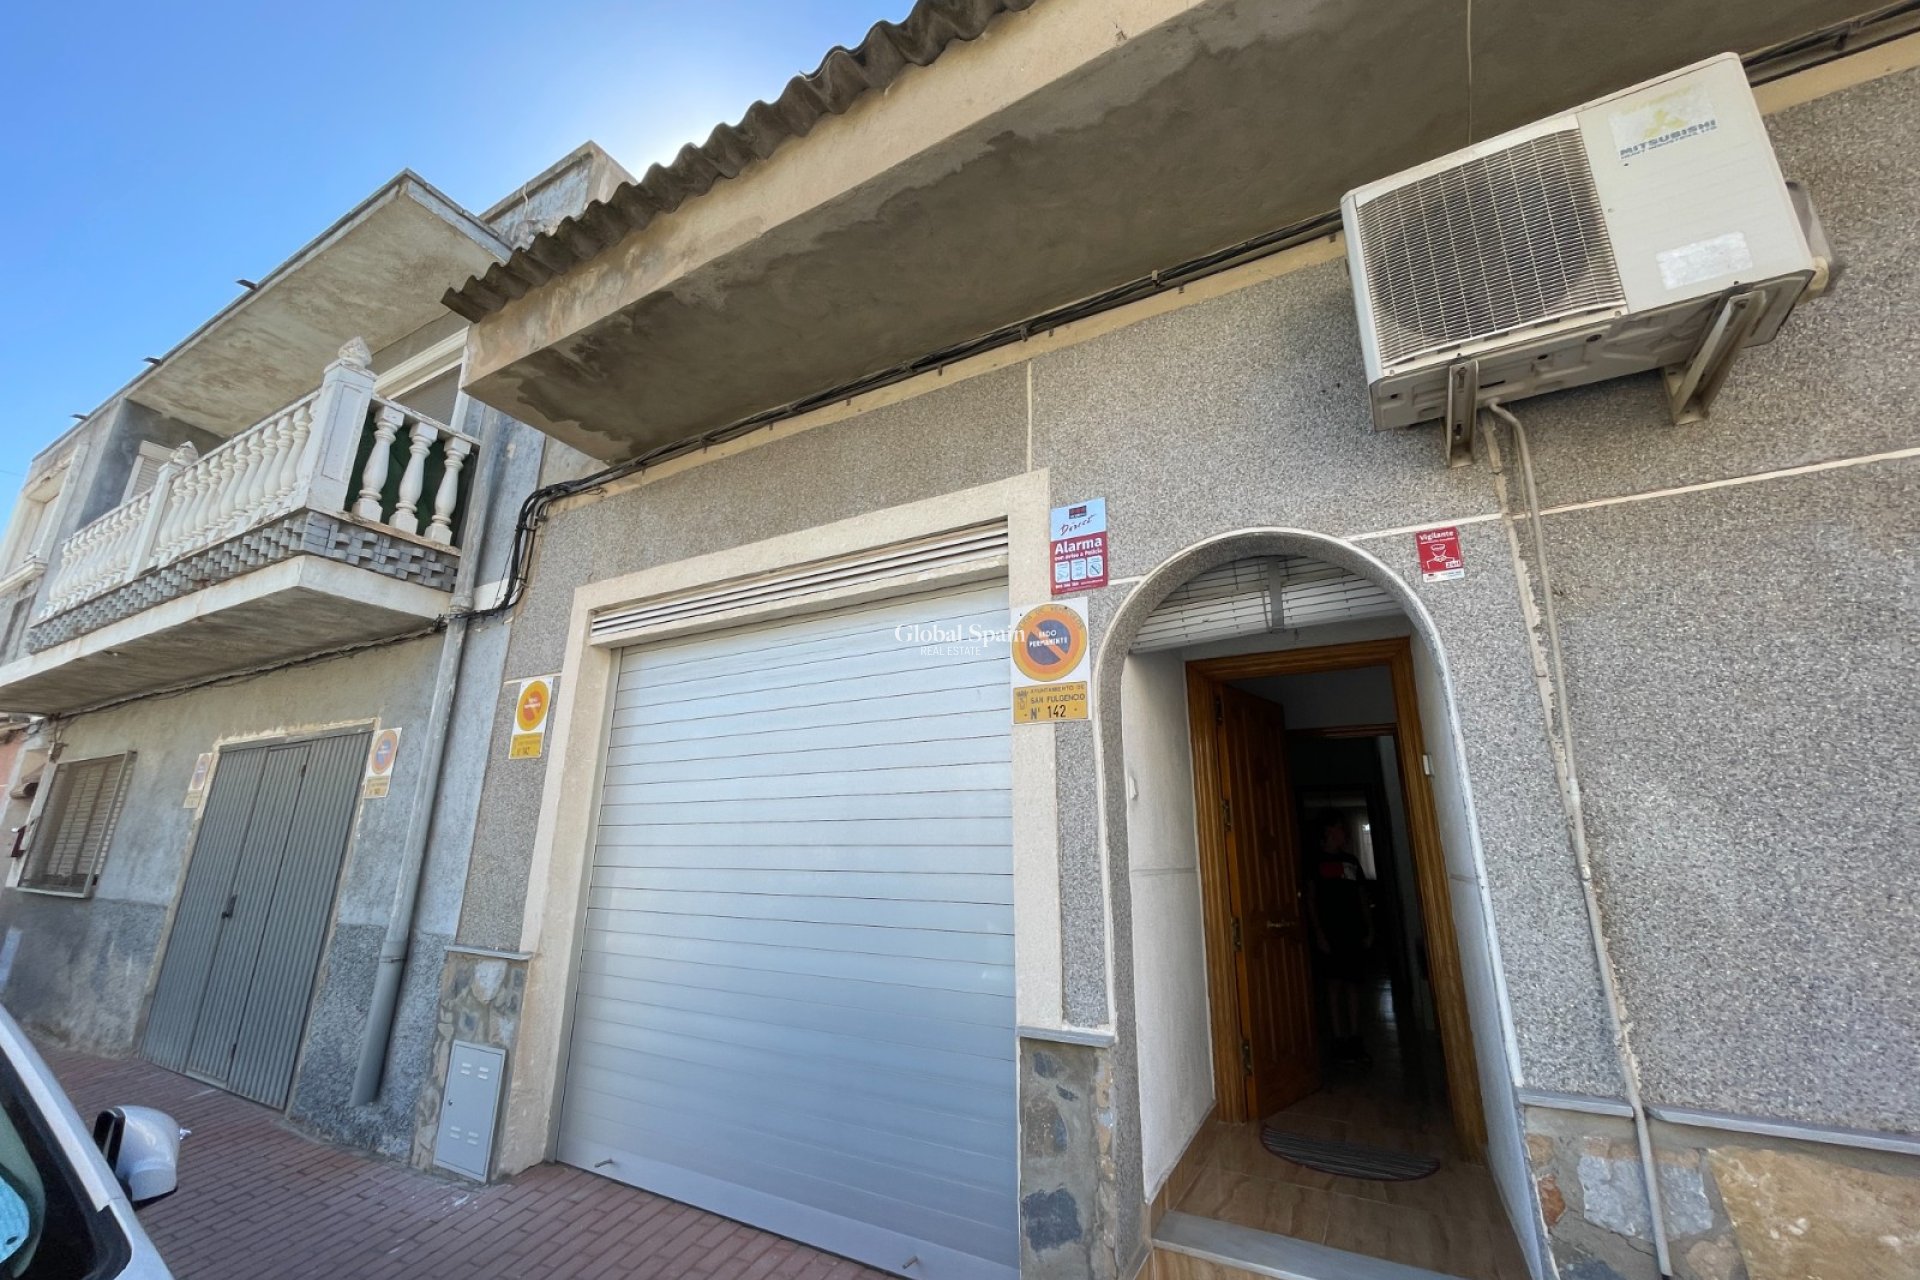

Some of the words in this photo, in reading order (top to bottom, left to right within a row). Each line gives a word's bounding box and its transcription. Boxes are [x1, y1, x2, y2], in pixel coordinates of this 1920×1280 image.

[1620, 120, 1715, 155] MITSUBISHI
[1060, 513, 1096, 536] Direct
[1419, 531, 1454, 541] Vigilante
[1055, 537, 1103, 555] Alarma
[1029, 637, 1068, 648] PERMANENTE
[1031, 696, 1044, 704] SAN
[1047, 704, 1067, 718] 142
